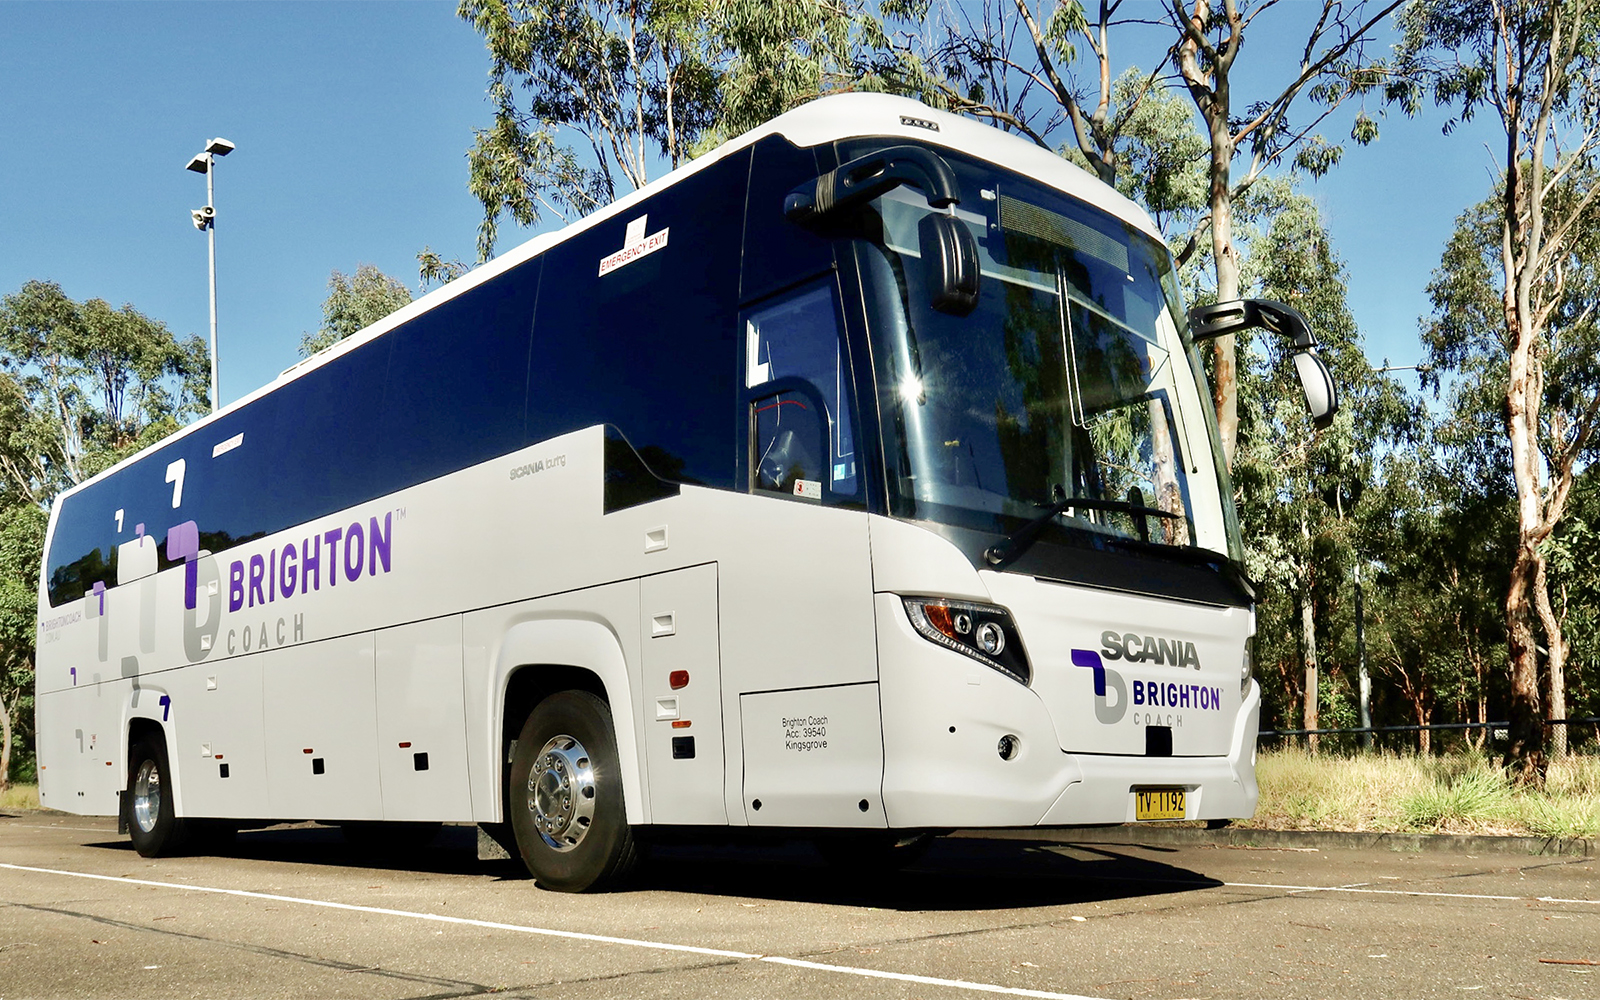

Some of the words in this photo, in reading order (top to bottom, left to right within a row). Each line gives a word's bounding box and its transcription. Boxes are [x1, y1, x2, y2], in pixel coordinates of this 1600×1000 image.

[600, 242, 648, 272] EMERGENCY
[648, 232, 667, 249] EXIT
[509, 460, 545, 481] SCANIA
[545, 454, 566, 470] touring
[228, 511, 393, 613] BRIGHTON
[227, 612, 304, 656] COACH
[1100, 630, 1201, 671] SCANIA
[1133, 680, 1220, 711] BRIGHTON
[781, 717, 807, 729] Brighton
[807, 715, 829, 726] Coach
[802, 726, 827, 738] 39540
[1133, 712, 1183, 728] COACH
[785, 740, 828, 752] Kingsgrove
